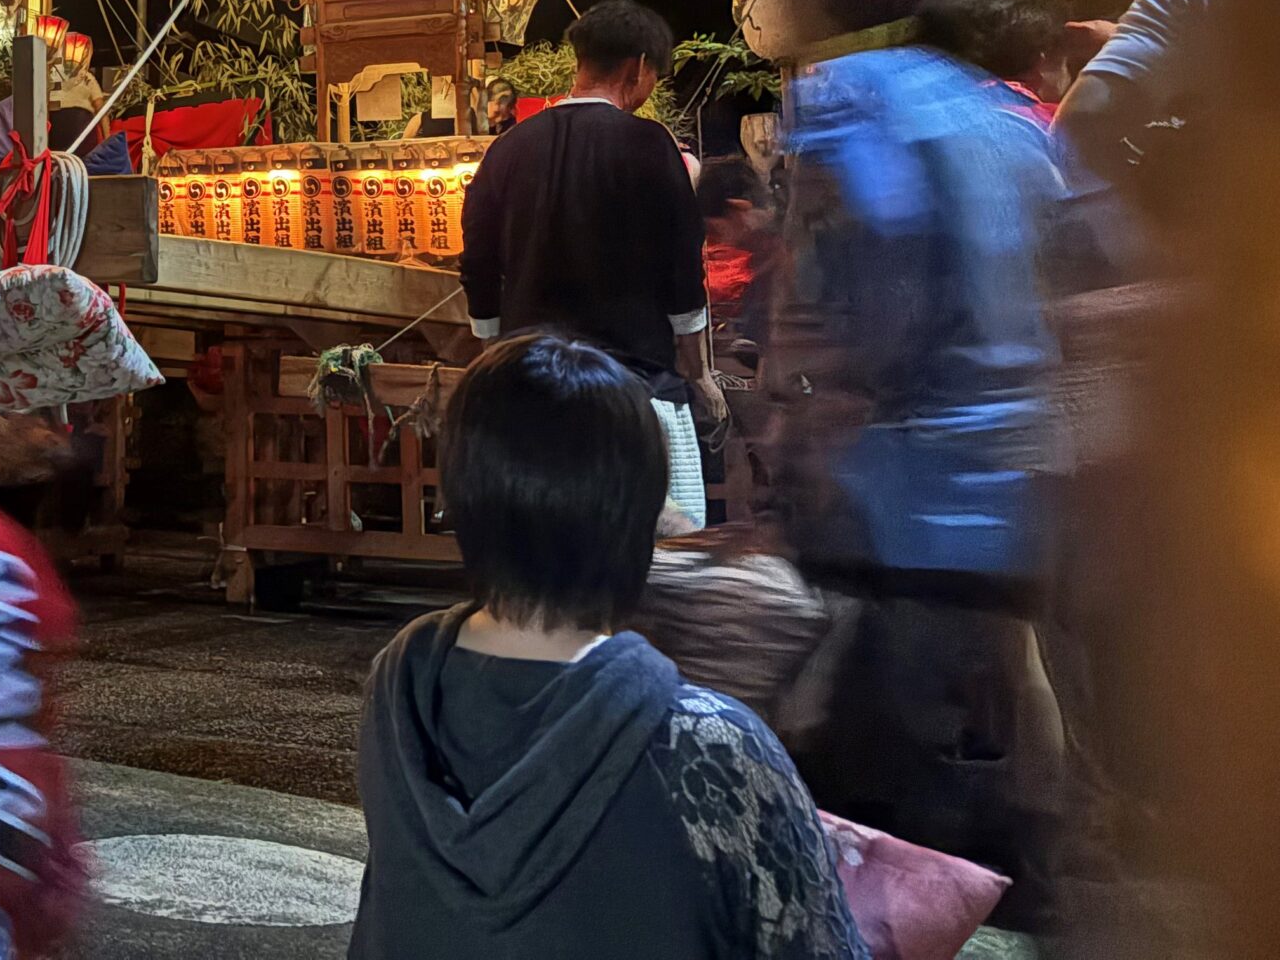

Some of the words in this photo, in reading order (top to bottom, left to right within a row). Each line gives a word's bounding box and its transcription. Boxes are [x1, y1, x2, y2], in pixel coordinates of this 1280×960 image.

[214, 202, 231, 241] 濱出
[364, 199, 386, 250] 濱出組
[428, 198, 450, 250] 濱出組
